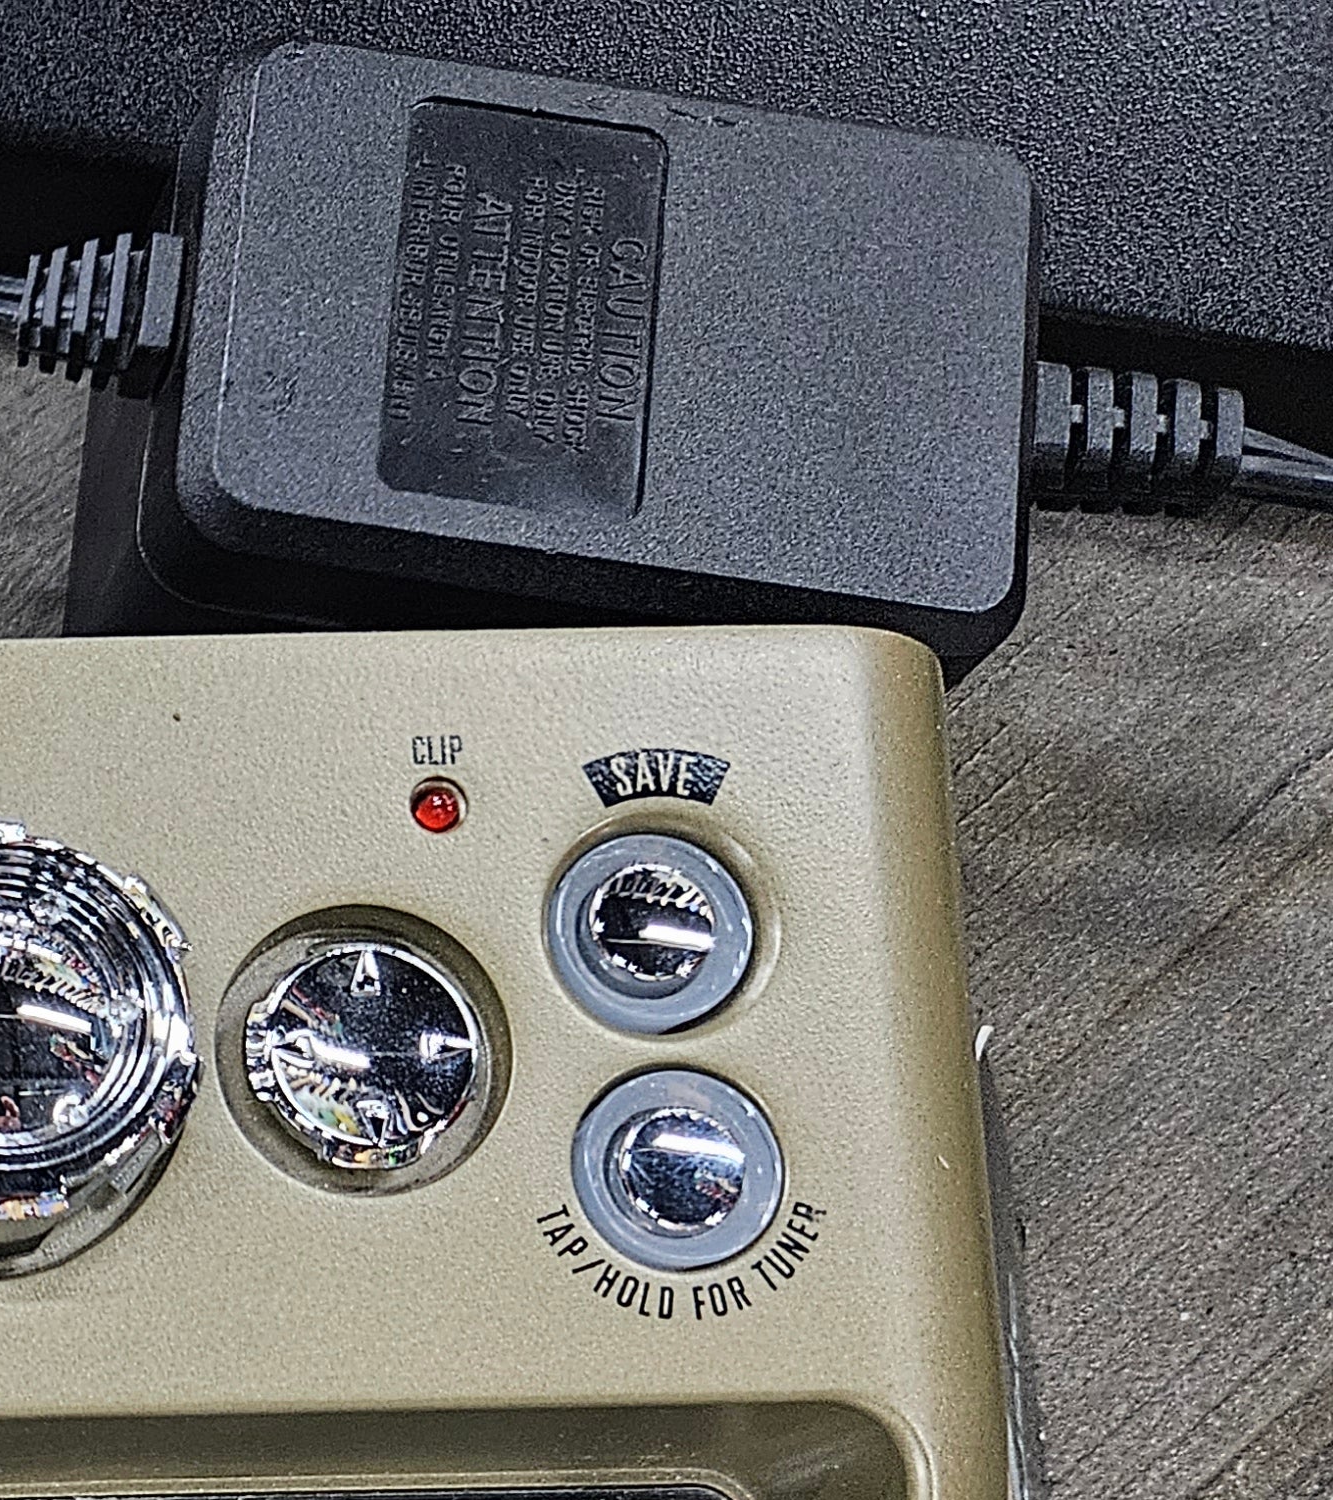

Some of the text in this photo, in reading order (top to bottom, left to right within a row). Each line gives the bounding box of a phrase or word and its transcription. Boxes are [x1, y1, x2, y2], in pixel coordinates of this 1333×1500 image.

[438, 162, 467, 223] POUR
[425, 234, 460, 361] UTILISATION
[452, 190, 513, 427] ATTENTION
[505, 175, 548, 420] FOR INDOOR USE ONLY
[531, 181, 576, 444] DRY LOCATION USE ONLY
[561, 186, 604, 454] RISK OF ELECTRIC SHOCK
[595, 237, 648, 423] CAUTION
[412, 735, 463, 766] CLIP
[610, 752, 695, 797] SAVE
[536, 1201, 820, 1320] TAP/HOLD FOR TUNER
